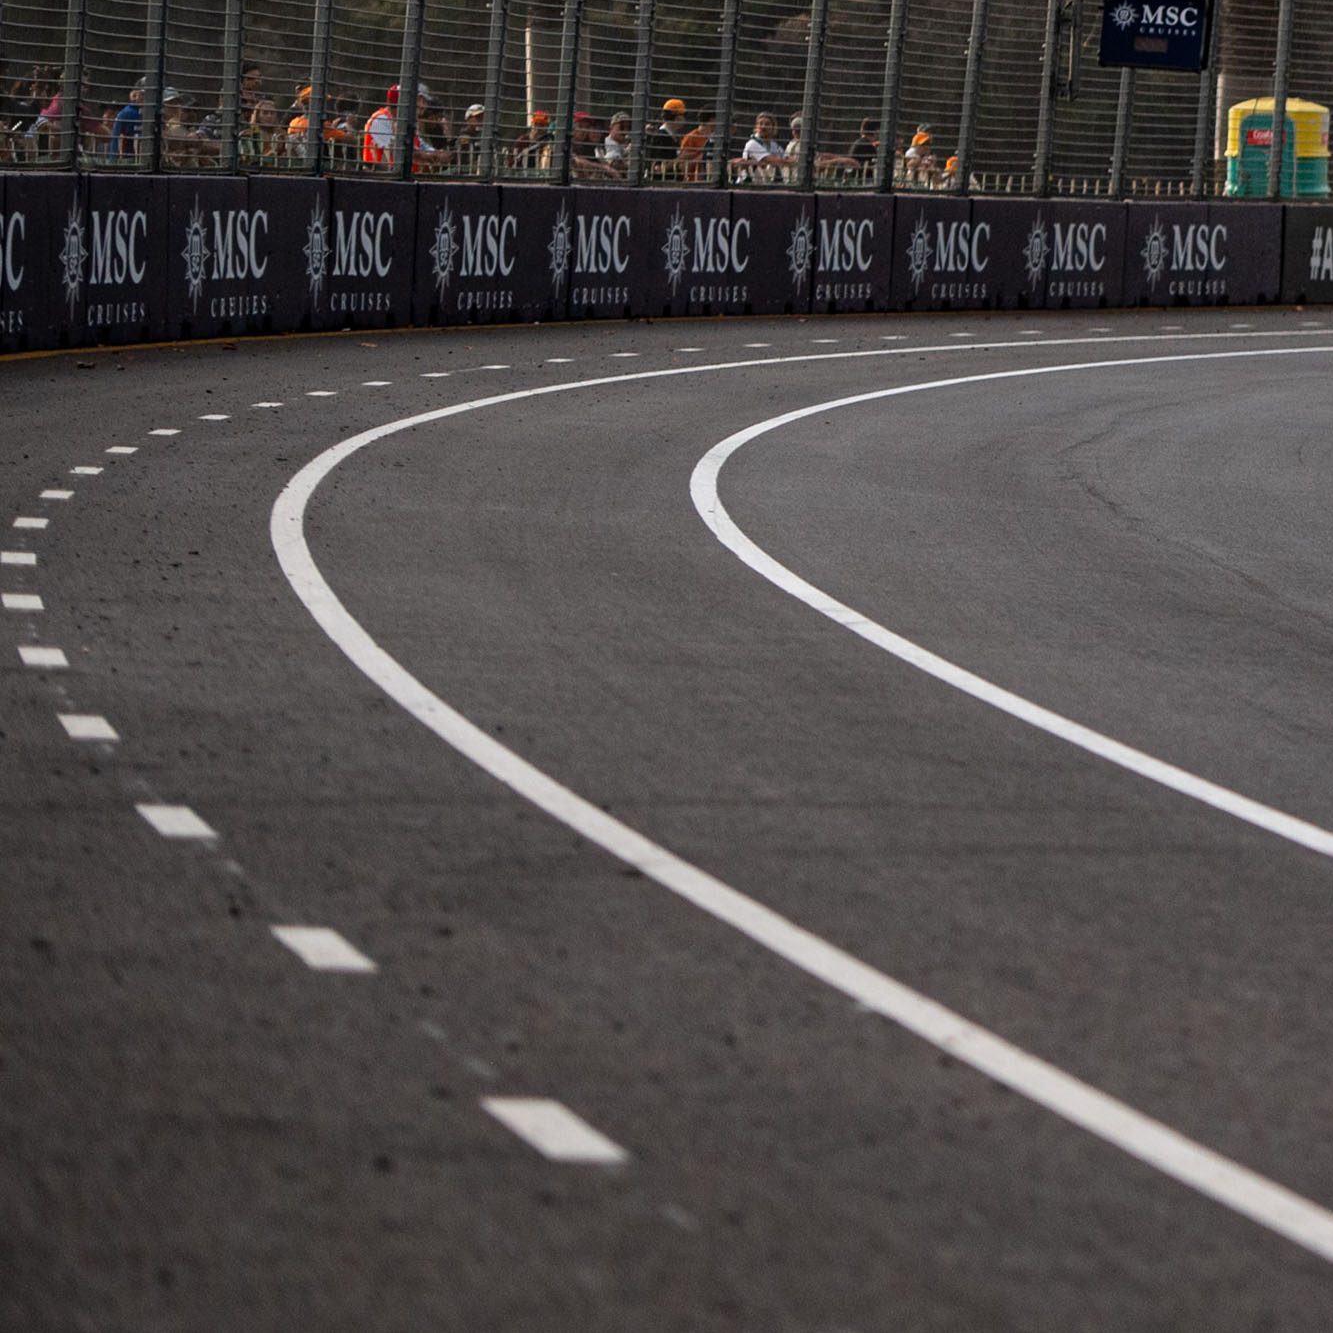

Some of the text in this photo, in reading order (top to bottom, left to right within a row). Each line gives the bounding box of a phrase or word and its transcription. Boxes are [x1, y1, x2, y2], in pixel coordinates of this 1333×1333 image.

[1140, 4, 1198, 27] MSC
[89, 210, 147, 284] MSC
[211, 210, 269, 279] MSC
[332, 211, 394, 277] MSC
[459, 215, 517, 276] MSC
[574, 215, 631, 274] MSC
[691, 217, 750, 273] MSC
[817, 219, 874, 272] MSC
[933, 221, 990, 272] MSC
[1051, 223, 1107, 271] MSC
[1170, 224, 1227, 271] MSC
[88, 302, 145, 327] CRUISES
[331, 292, 391, 311] CRUISES
[573, 287, 629, 305] CRUISES
[690, 286, 748, 302] CRUISES
[816, 283, 872, 300] CRUISES
[931, 282, 987, 299] CRUISES
